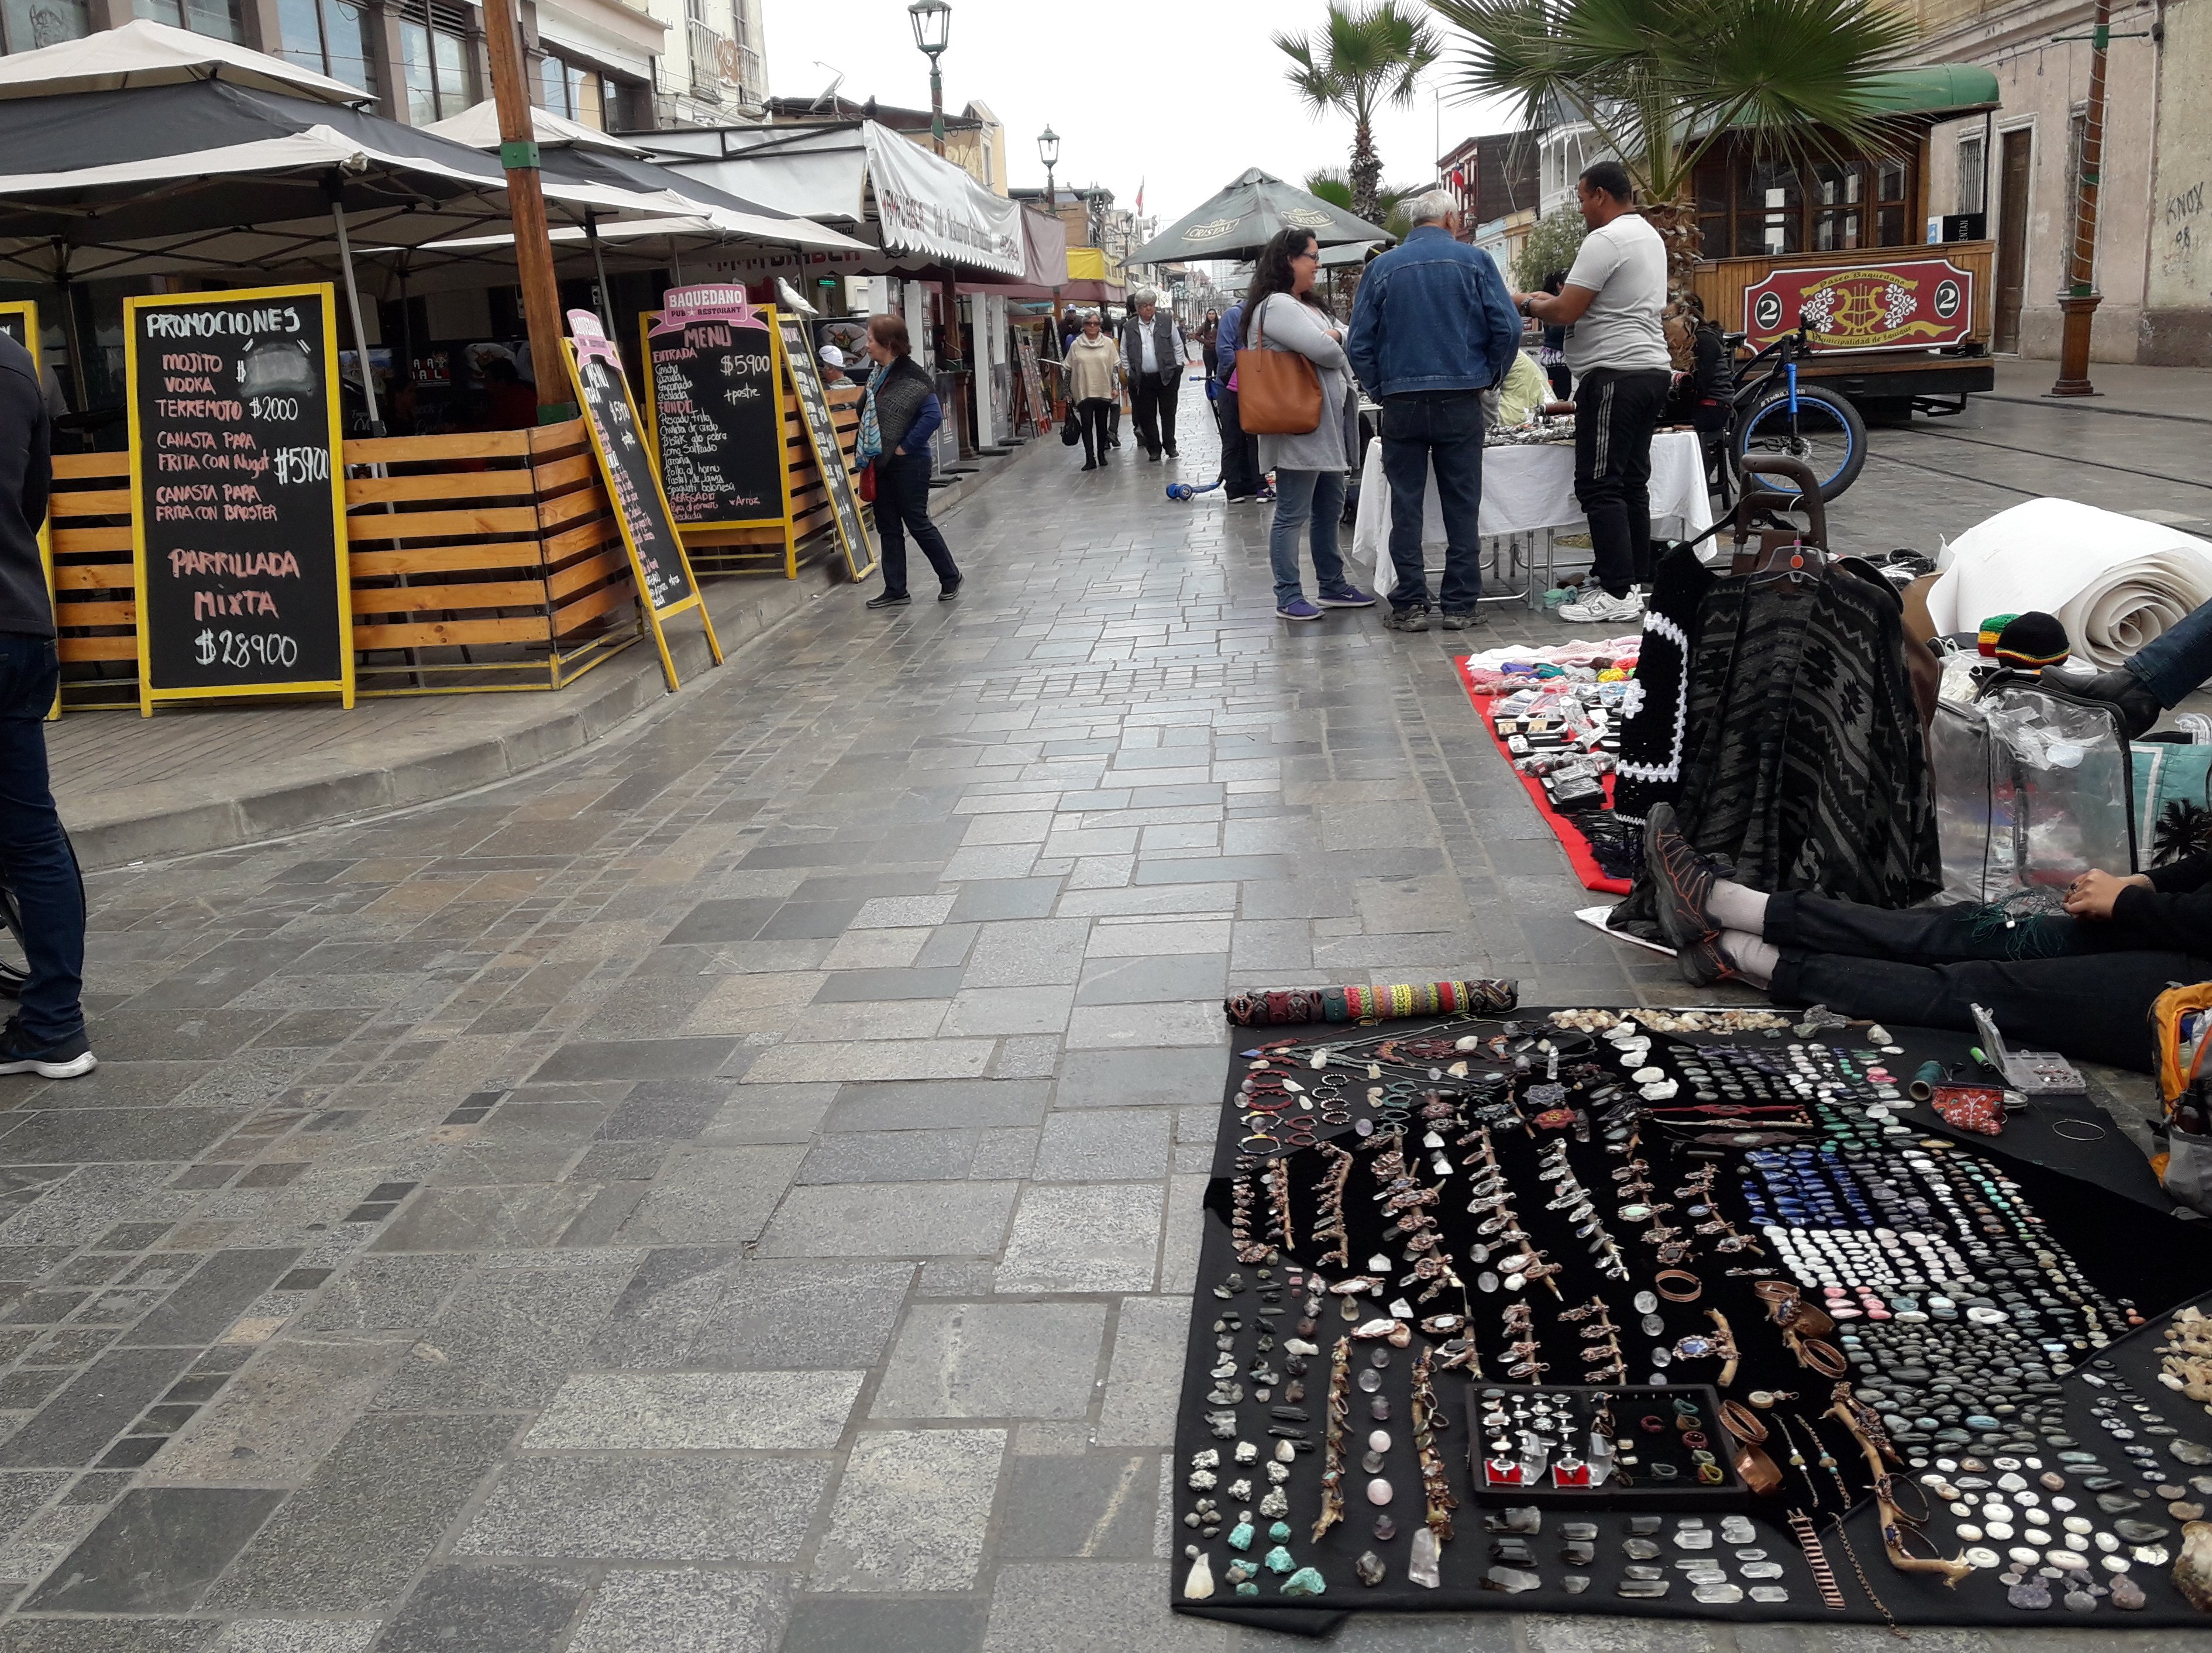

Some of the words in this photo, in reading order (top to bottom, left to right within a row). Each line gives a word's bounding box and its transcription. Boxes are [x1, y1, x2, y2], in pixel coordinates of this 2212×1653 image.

[1288, 214, 1327, 225] CRISTAL
[1189, 223, 1234, 238] CRISTAL
[1819, 275, 1849, 288] Paseo
[1853, 272, 1905, 285] Baquedano
[669, 289, 742, 308] BAQUEDANO
[1938, 288, 1956, 310] 2
[1760, 300, 1777, 321] 2
[146, 306, 301, 339] PROMOCIONES
[683, 325, 732, 349] MENU
[162, 352, 225, 374] MOJITO
[652, 346, 697, 363] ENTRADA
[720, 354, 770, 377] $5900
[164, 376, 216, 396] VODKA
[154, 398, 243, 422] TERREMOTO
[249, 396, 298, 422] $2000
[157, 431, 218, 450] CANASTA
[222, 431, 257, 450] PAPA
[158, 453, 201, 472] FRITA
[202, 453, 230, 470] CON
[156, 484, 219, 504] CANASTA
[222, 484, 263, 504] PAPA
[167, 548, 301, 579] PARRILLADA
[194, 584, 280, 621] MIXTA
[194, 627, 298, 668] $28900
